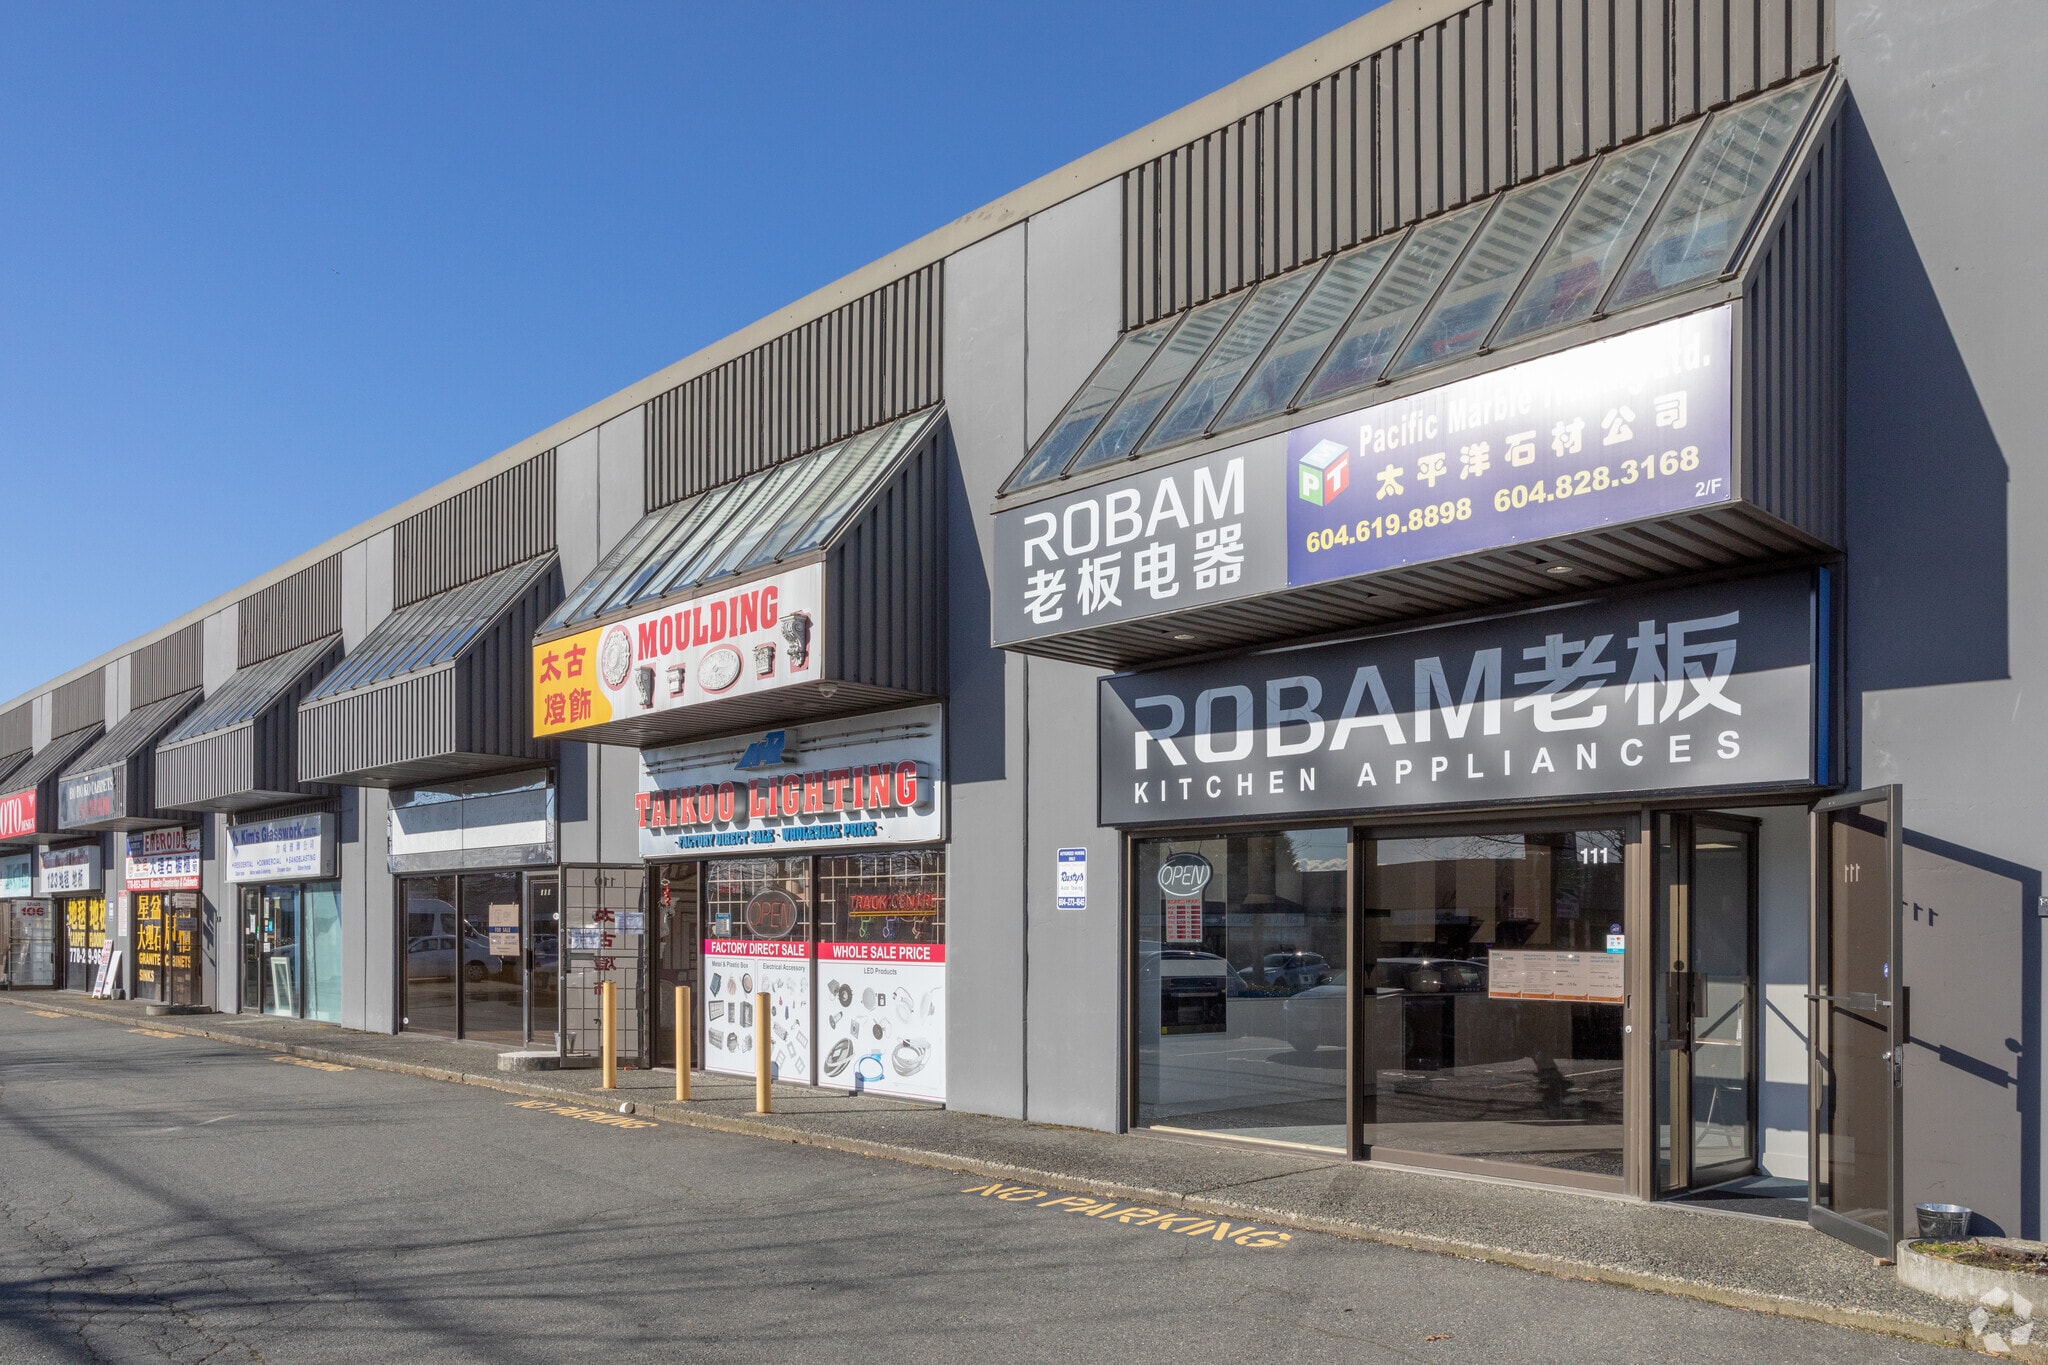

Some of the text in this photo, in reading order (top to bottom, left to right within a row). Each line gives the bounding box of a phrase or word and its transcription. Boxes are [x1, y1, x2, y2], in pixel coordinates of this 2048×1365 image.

[1360, 409, 1437, 457] Pacific
[1376, 390, 1688, 500] 太平洋石材公司
[1306, 446, 1700, 554] 604.619.8898 604.828.3168
[1695, 477, 1722, 498] 2/F
[1023, 457, 1245, 567] ROBAM
[1023, 522, 1245, 625] 老板电器
[637, 585, 779, 661] MOULDING
[539, 643, 587, 684] 太古
[1134, 729, 1742, 805] KITCHEN APPLIANCES
[634, 758, 919, 830] TAIKOO LIGHTING
[240, 829, 260, 845] Kim's
[261, 822, 302, 841] Glasswork
[678, 821, 878, 849] FACTORY DIRECT SALE WHOLESALE PRICE
[1580, 847, 1608, 864] 111
[1161, 865, 1205, 885] OPEN
[21, 907, 44, 916] 106
[749, 901, 792, 928] OPEN
[138, 953, 191, 968] GRANITE CBINETS
[711, 941, 805, 956] FACTORY DIRECT SALE
[832, 945, 931, 960] WHOLE SALE PRICE
[138, 969, 154, 982] SINKS
[783, 964, 806, 973] Accessory
[863, 967, 897, 975] LED Products
[961, 1183, 1292, 1248] NO PARKING
